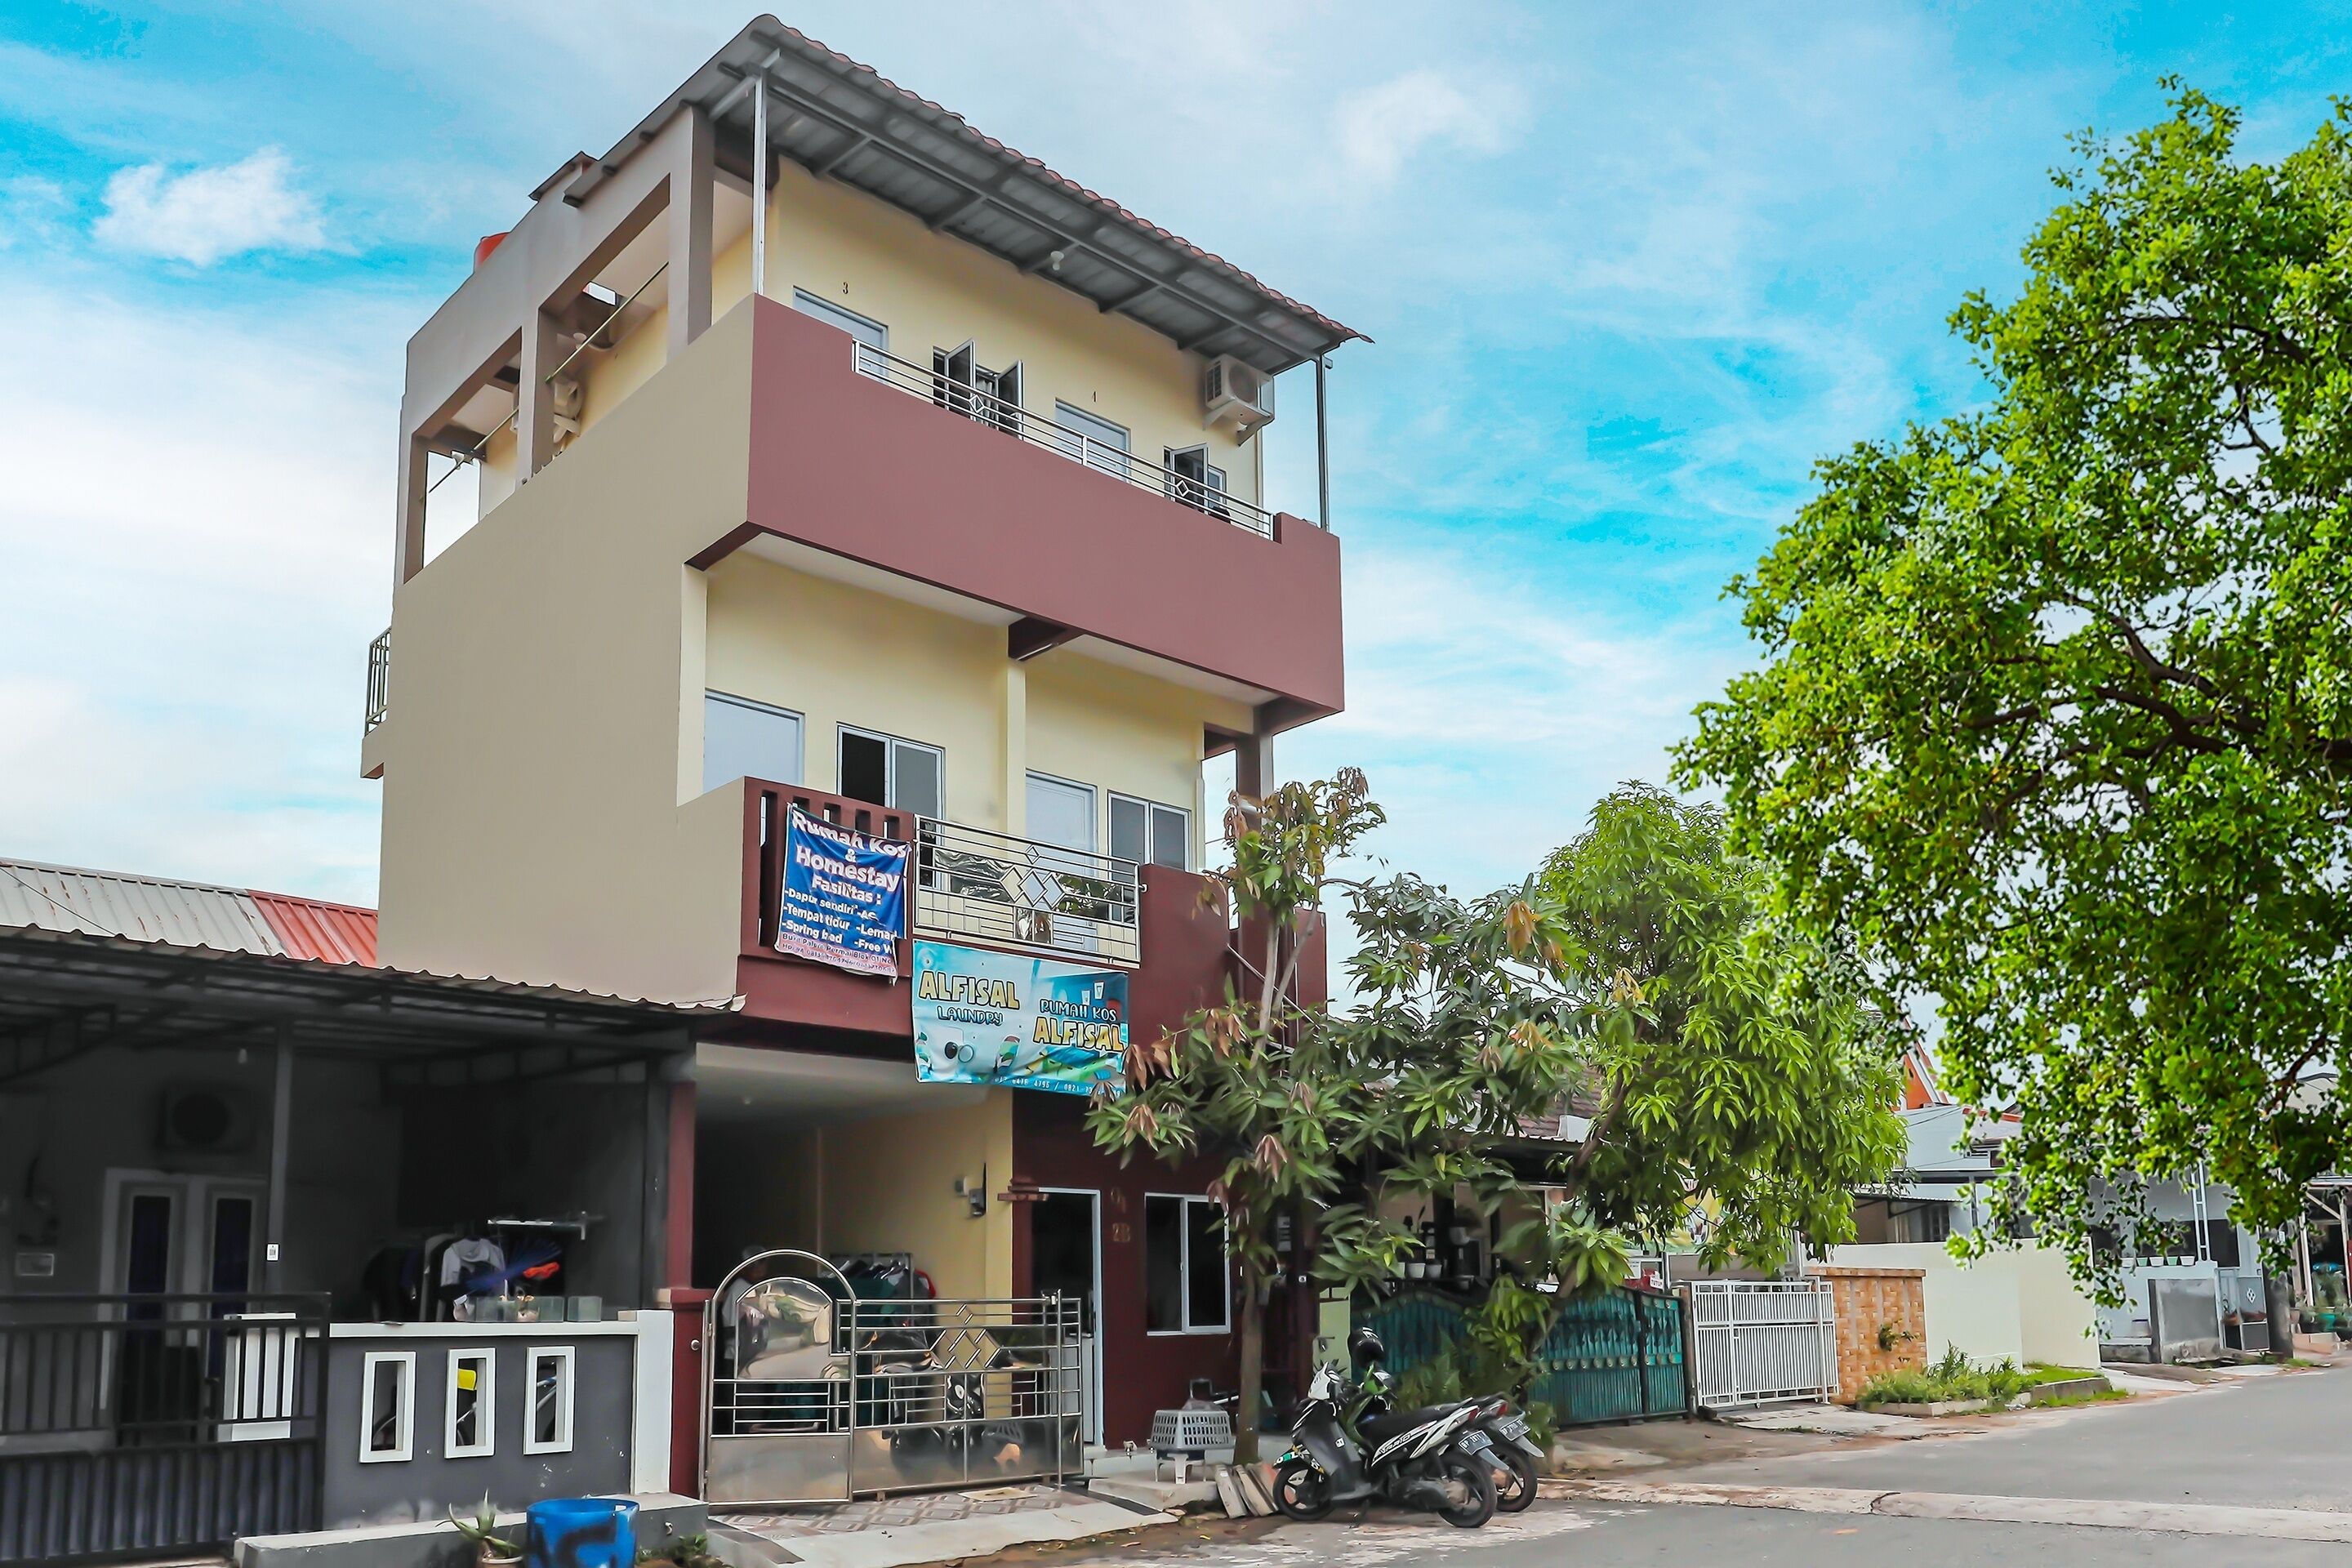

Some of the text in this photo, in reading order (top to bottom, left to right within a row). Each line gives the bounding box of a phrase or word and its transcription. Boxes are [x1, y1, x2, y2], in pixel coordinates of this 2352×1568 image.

[842, 281, 849, 295] 3
[791, 809, 865, 849] Rumah
[845, 848, 857, 862] &
[796, 844, 900, 892] Homestay
[825, 914, 850, 930] tidur
[822, 929, 843, 944] bed
[919, 970, 1020, 1010] ALFISAL
[938, 1005, 1004, 1027] LAUNDRY
[1040, 999, 1117, 1022] RUMAH KOS
[1032, 1016, 1126, 1054] ALFISAL
